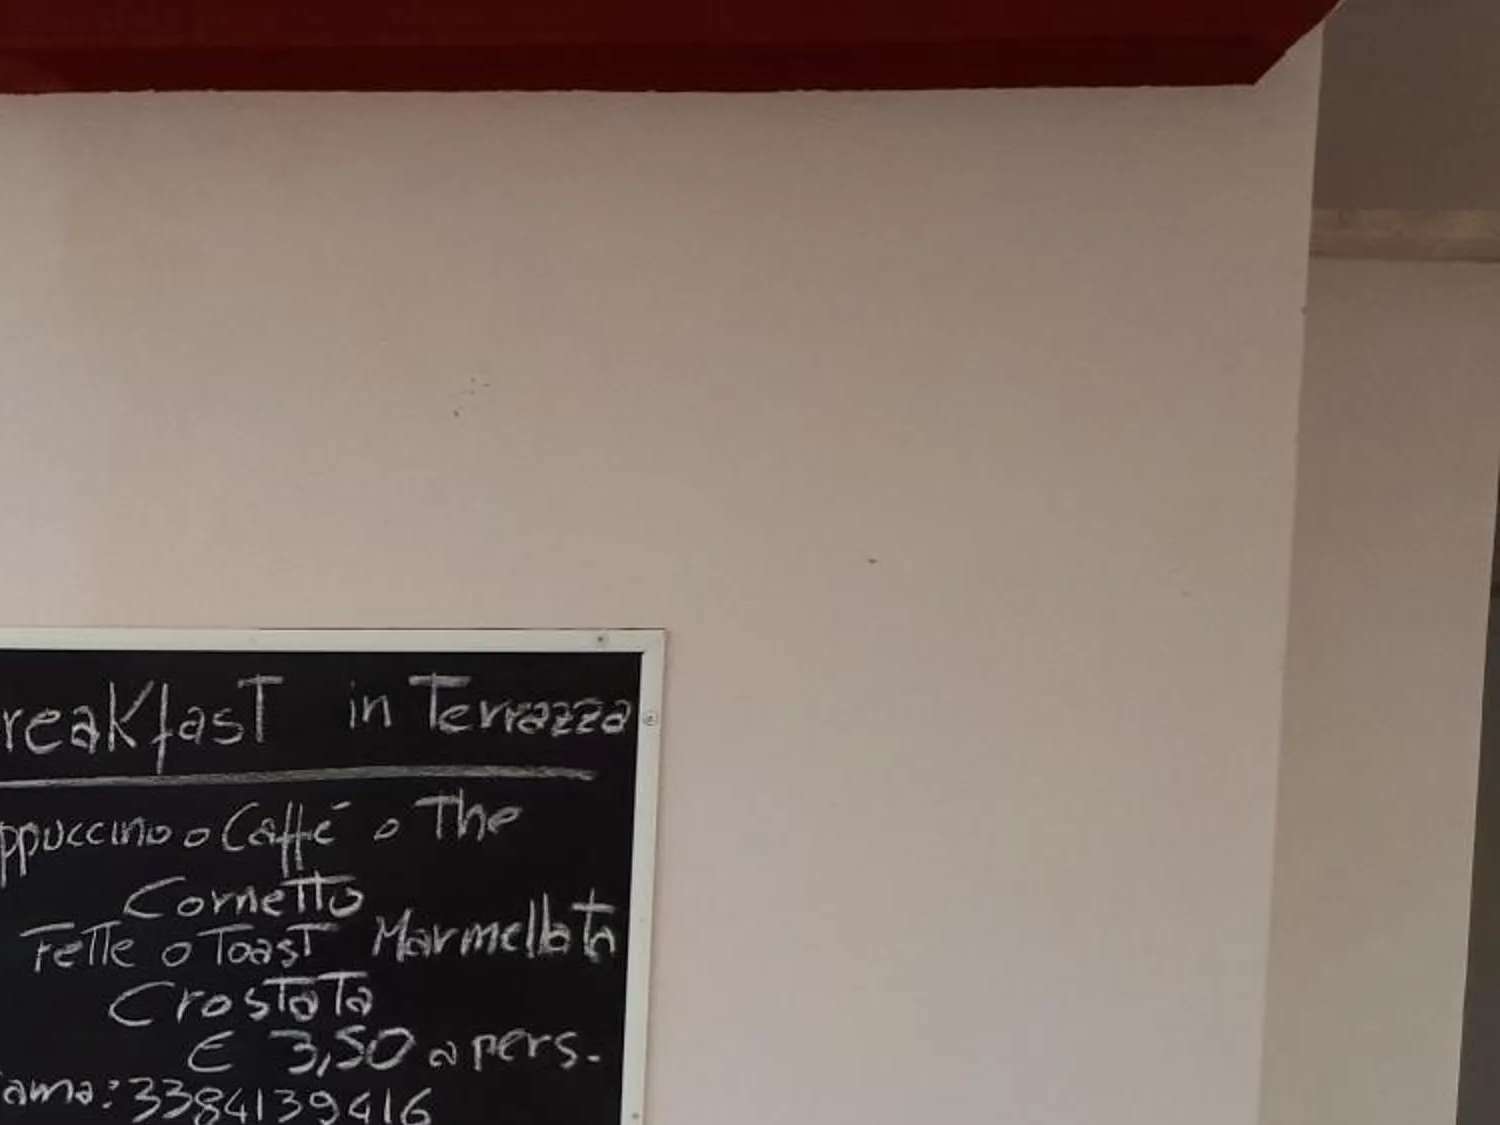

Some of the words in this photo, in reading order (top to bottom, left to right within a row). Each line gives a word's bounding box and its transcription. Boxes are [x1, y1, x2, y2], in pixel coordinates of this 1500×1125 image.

[349, 680, 392, 730] in
[408, 673, 631, 736] Terrazza
[414, 788, 523, 841] The
[268, 1025, 415, 1078] 3,50
[471, 1027, 601, 1072] pers.
